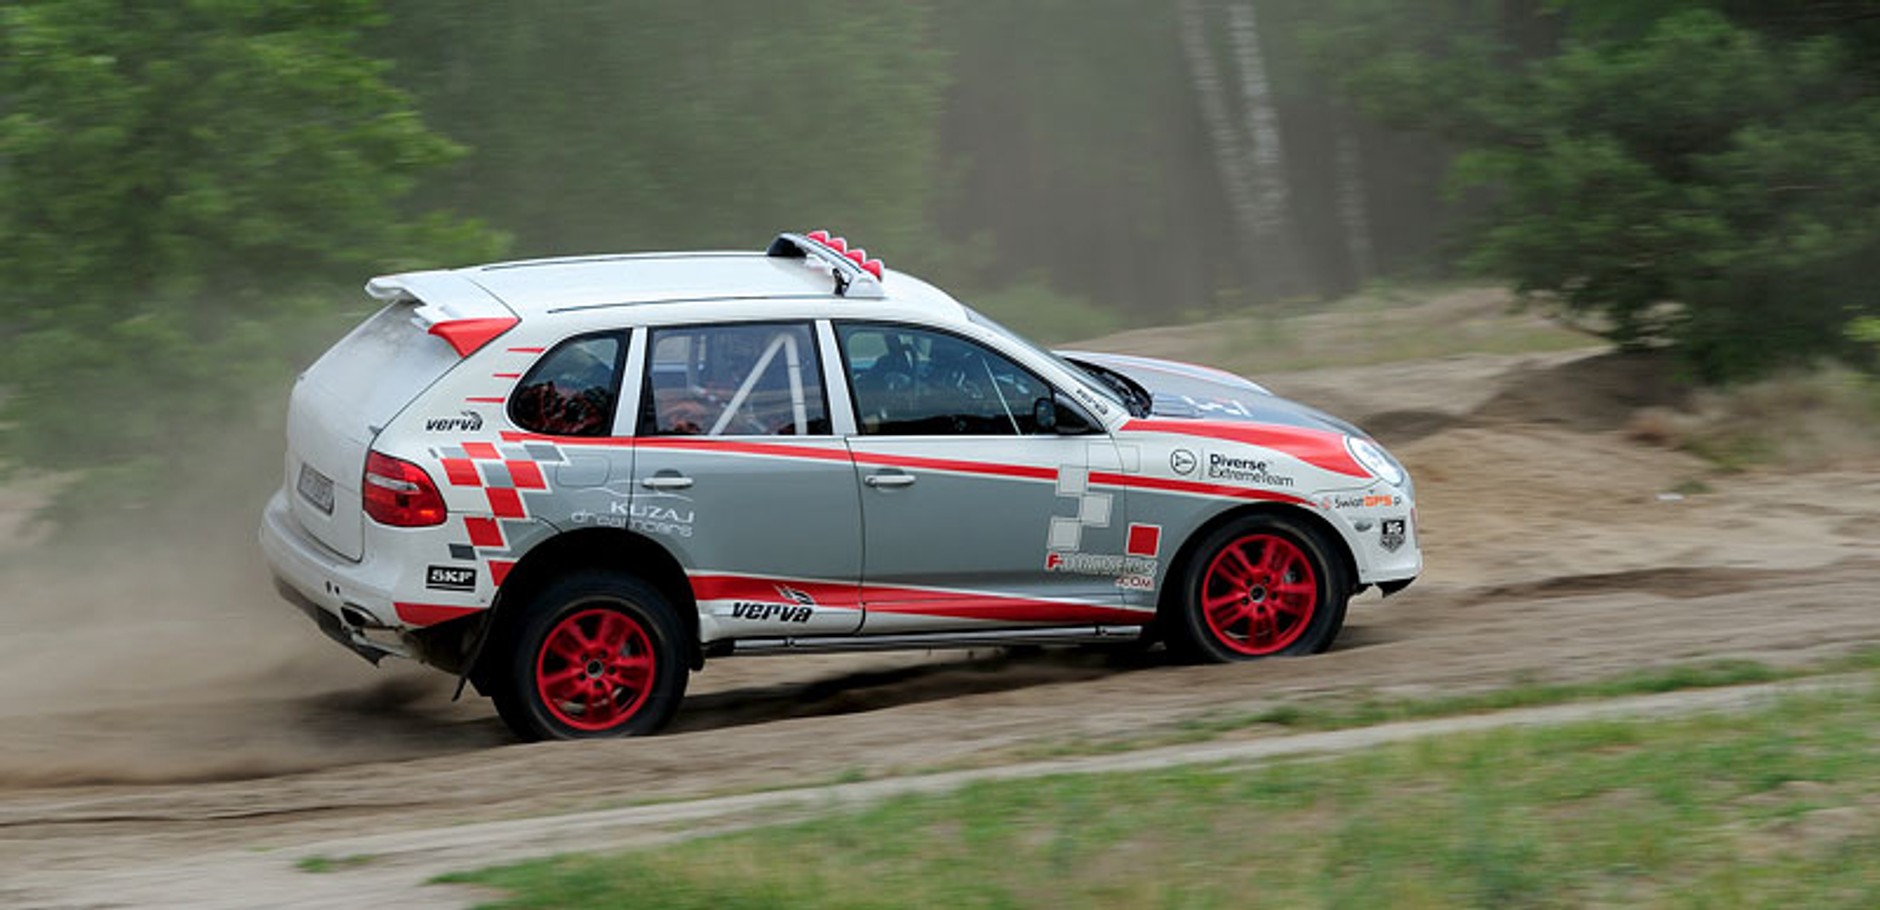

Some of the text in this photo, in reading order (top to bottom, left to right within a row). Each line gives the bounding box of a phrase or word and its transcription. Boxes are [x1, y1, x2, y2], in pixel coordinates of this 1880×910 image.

[426, 417, 483, 432] verva
[1209, 453, 1267, 472] Diverse
[1208, 465, 1295, 487] ExtremeTeam
[611, 501, 694, 523] KUZAJ
[571, 510, 693, 537] dreamcars
[431, 568, 473, 584] SKF
[731, 600, 813, 623] verva
